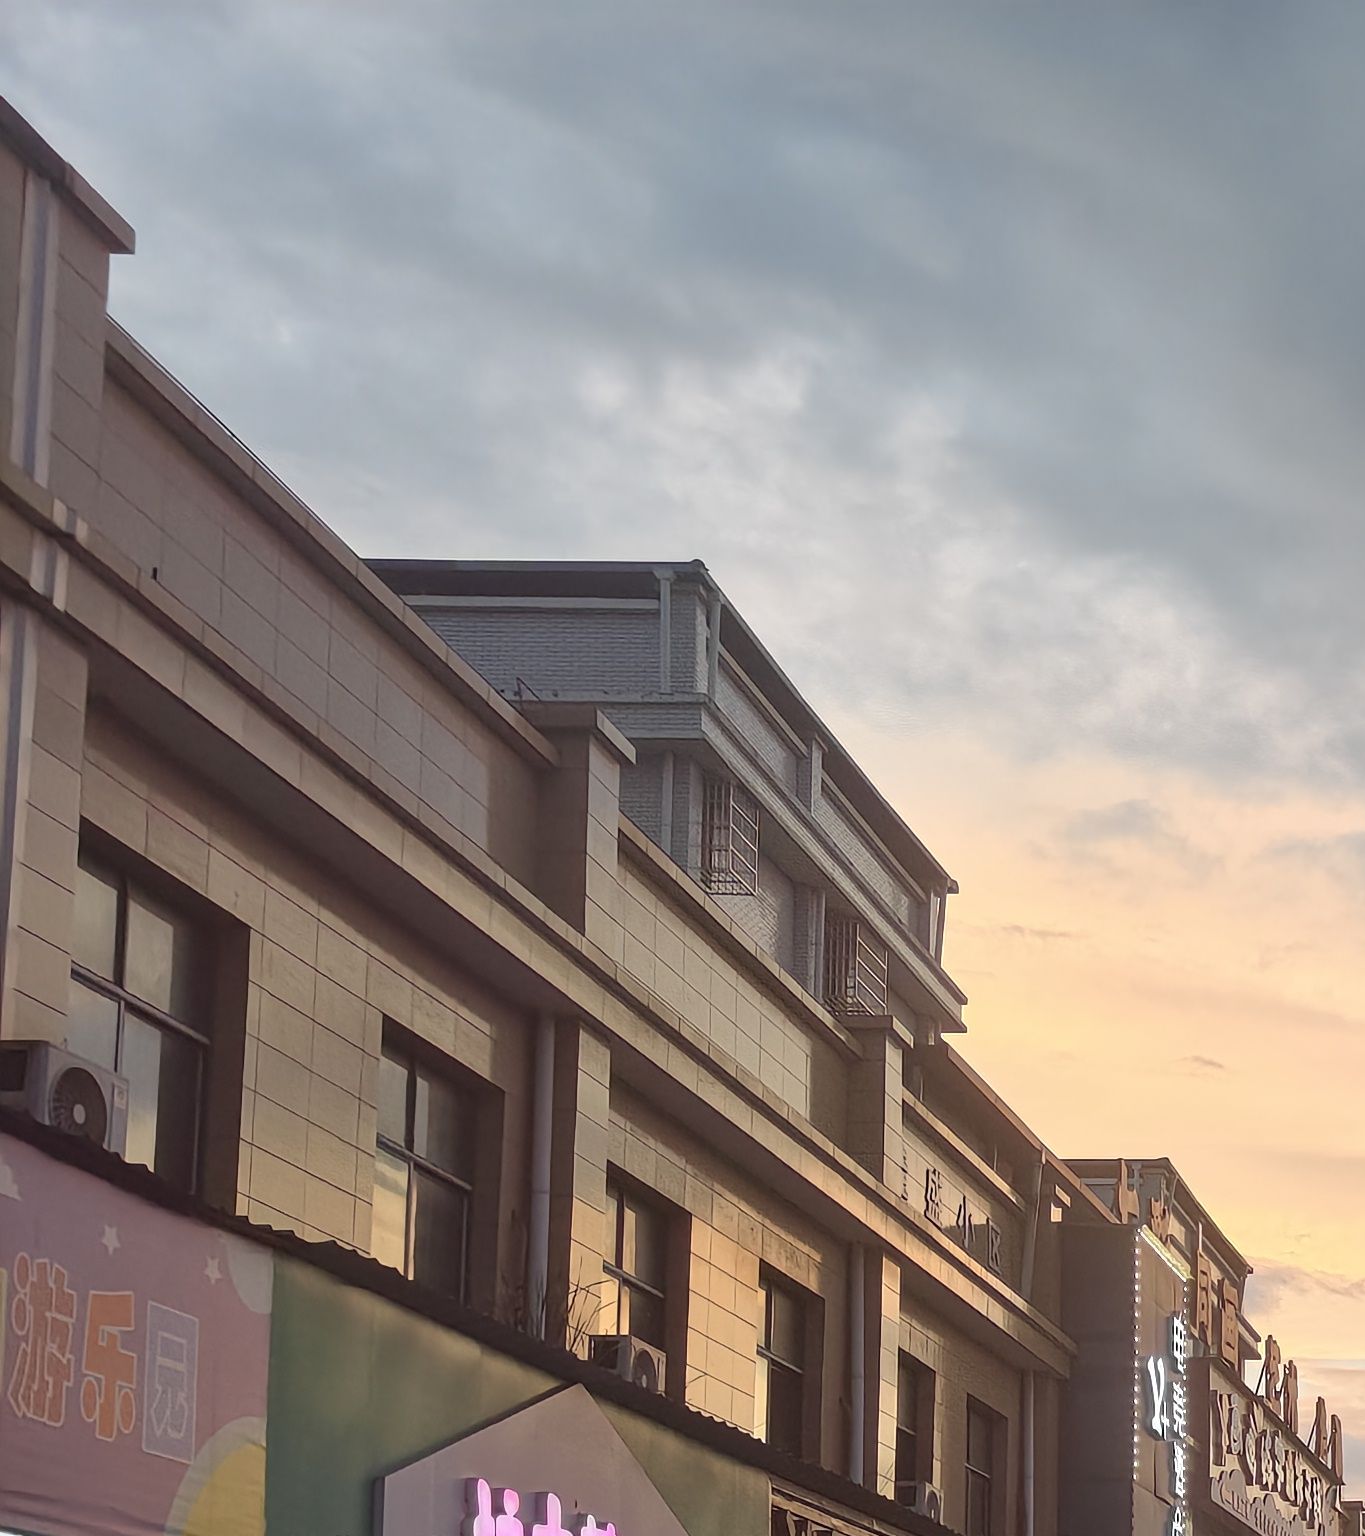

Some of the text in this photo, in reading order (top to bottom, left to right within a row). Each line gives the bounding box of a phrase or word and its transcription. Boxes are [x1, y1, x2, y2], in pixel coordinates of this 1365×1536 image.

[901, 1150, 1001, 1275] 盛小区
[9, 1252, 199, 1464] 游乐园
